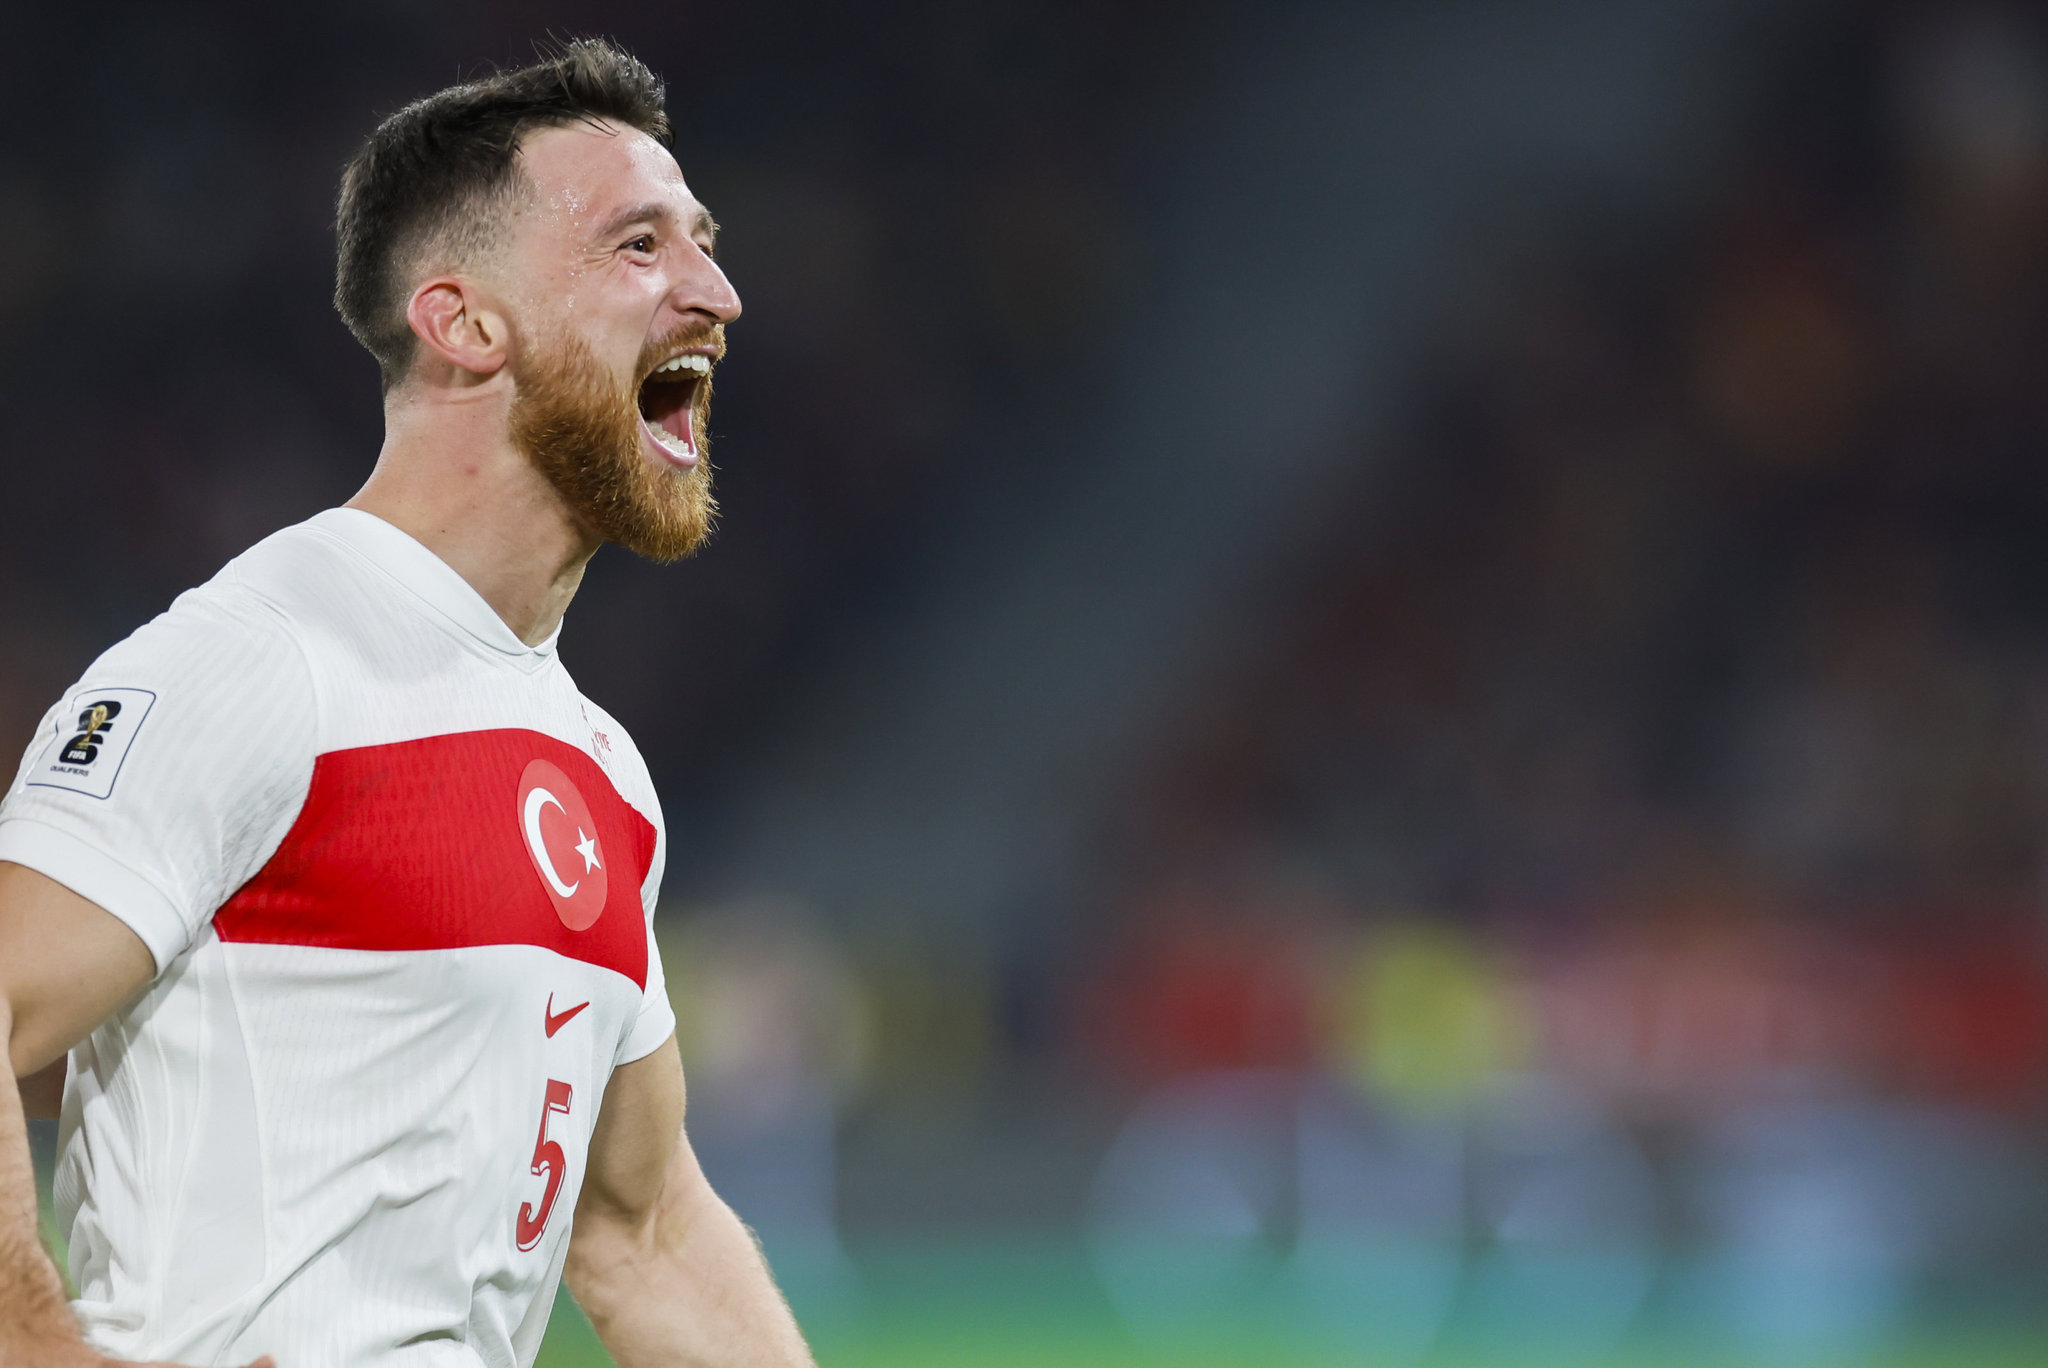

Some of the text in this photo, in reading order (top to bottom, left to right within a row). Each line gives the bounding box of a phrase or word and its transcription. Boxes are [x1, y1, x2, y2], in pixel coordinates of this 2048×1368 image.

[69, 750, 87, 760] FIFA
[50, 765, 89, 777] QUALIFIERS
[516, 1078, 573, 1251] 5
